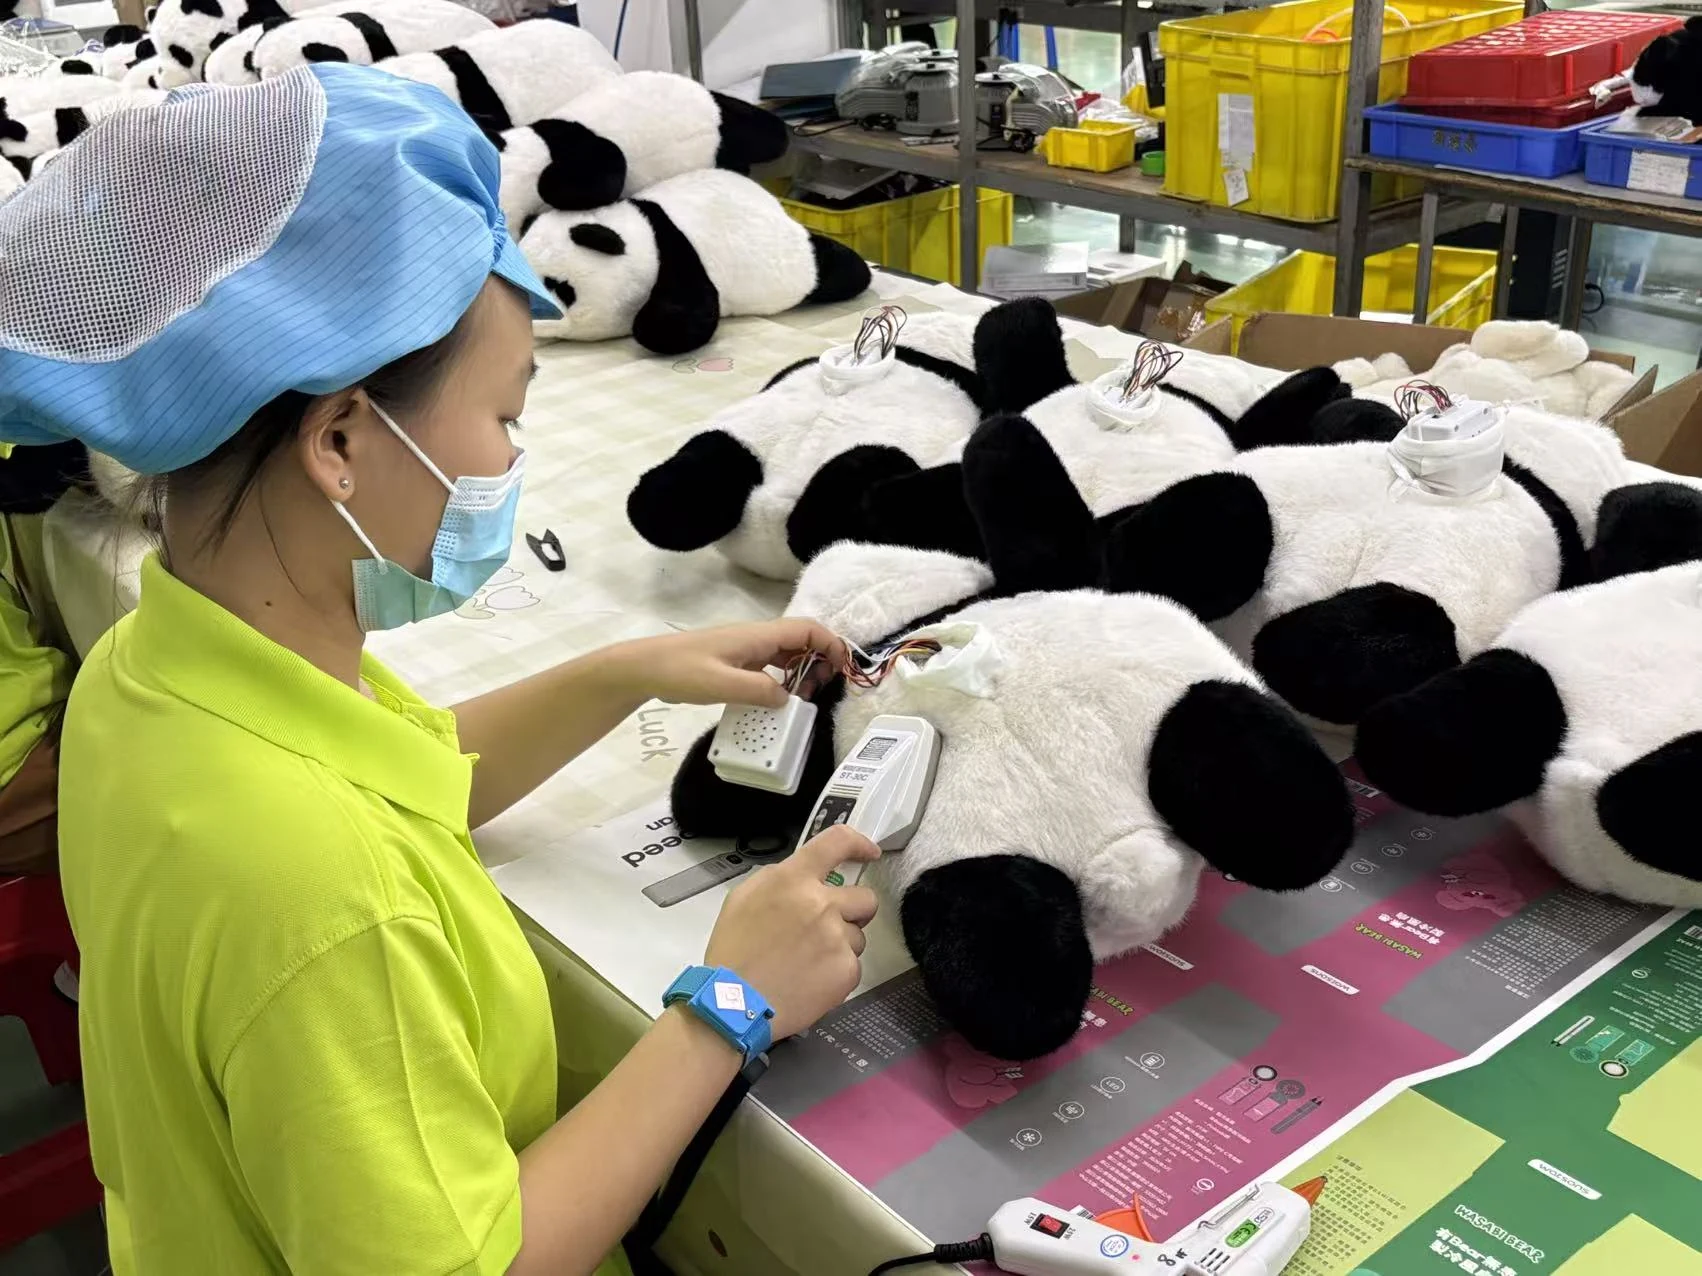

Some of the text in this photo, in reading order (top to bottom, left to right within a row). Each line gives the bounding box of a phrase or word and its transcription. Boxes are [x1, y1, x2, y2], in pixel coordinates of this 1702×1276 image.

[637, 707, 679, 762] Luck
[1149, 944, 1185, 967] watsons
[1354, 922, 1424, 960] WASABI BEAR
[1310, 967, 1350, 992] watsons
[1106, 996, 1134, 1016] BEAR
[1538, 1163, 1590, 1195] watsons
[1454, 1204, 1545, 1264] WASABI BEAR
